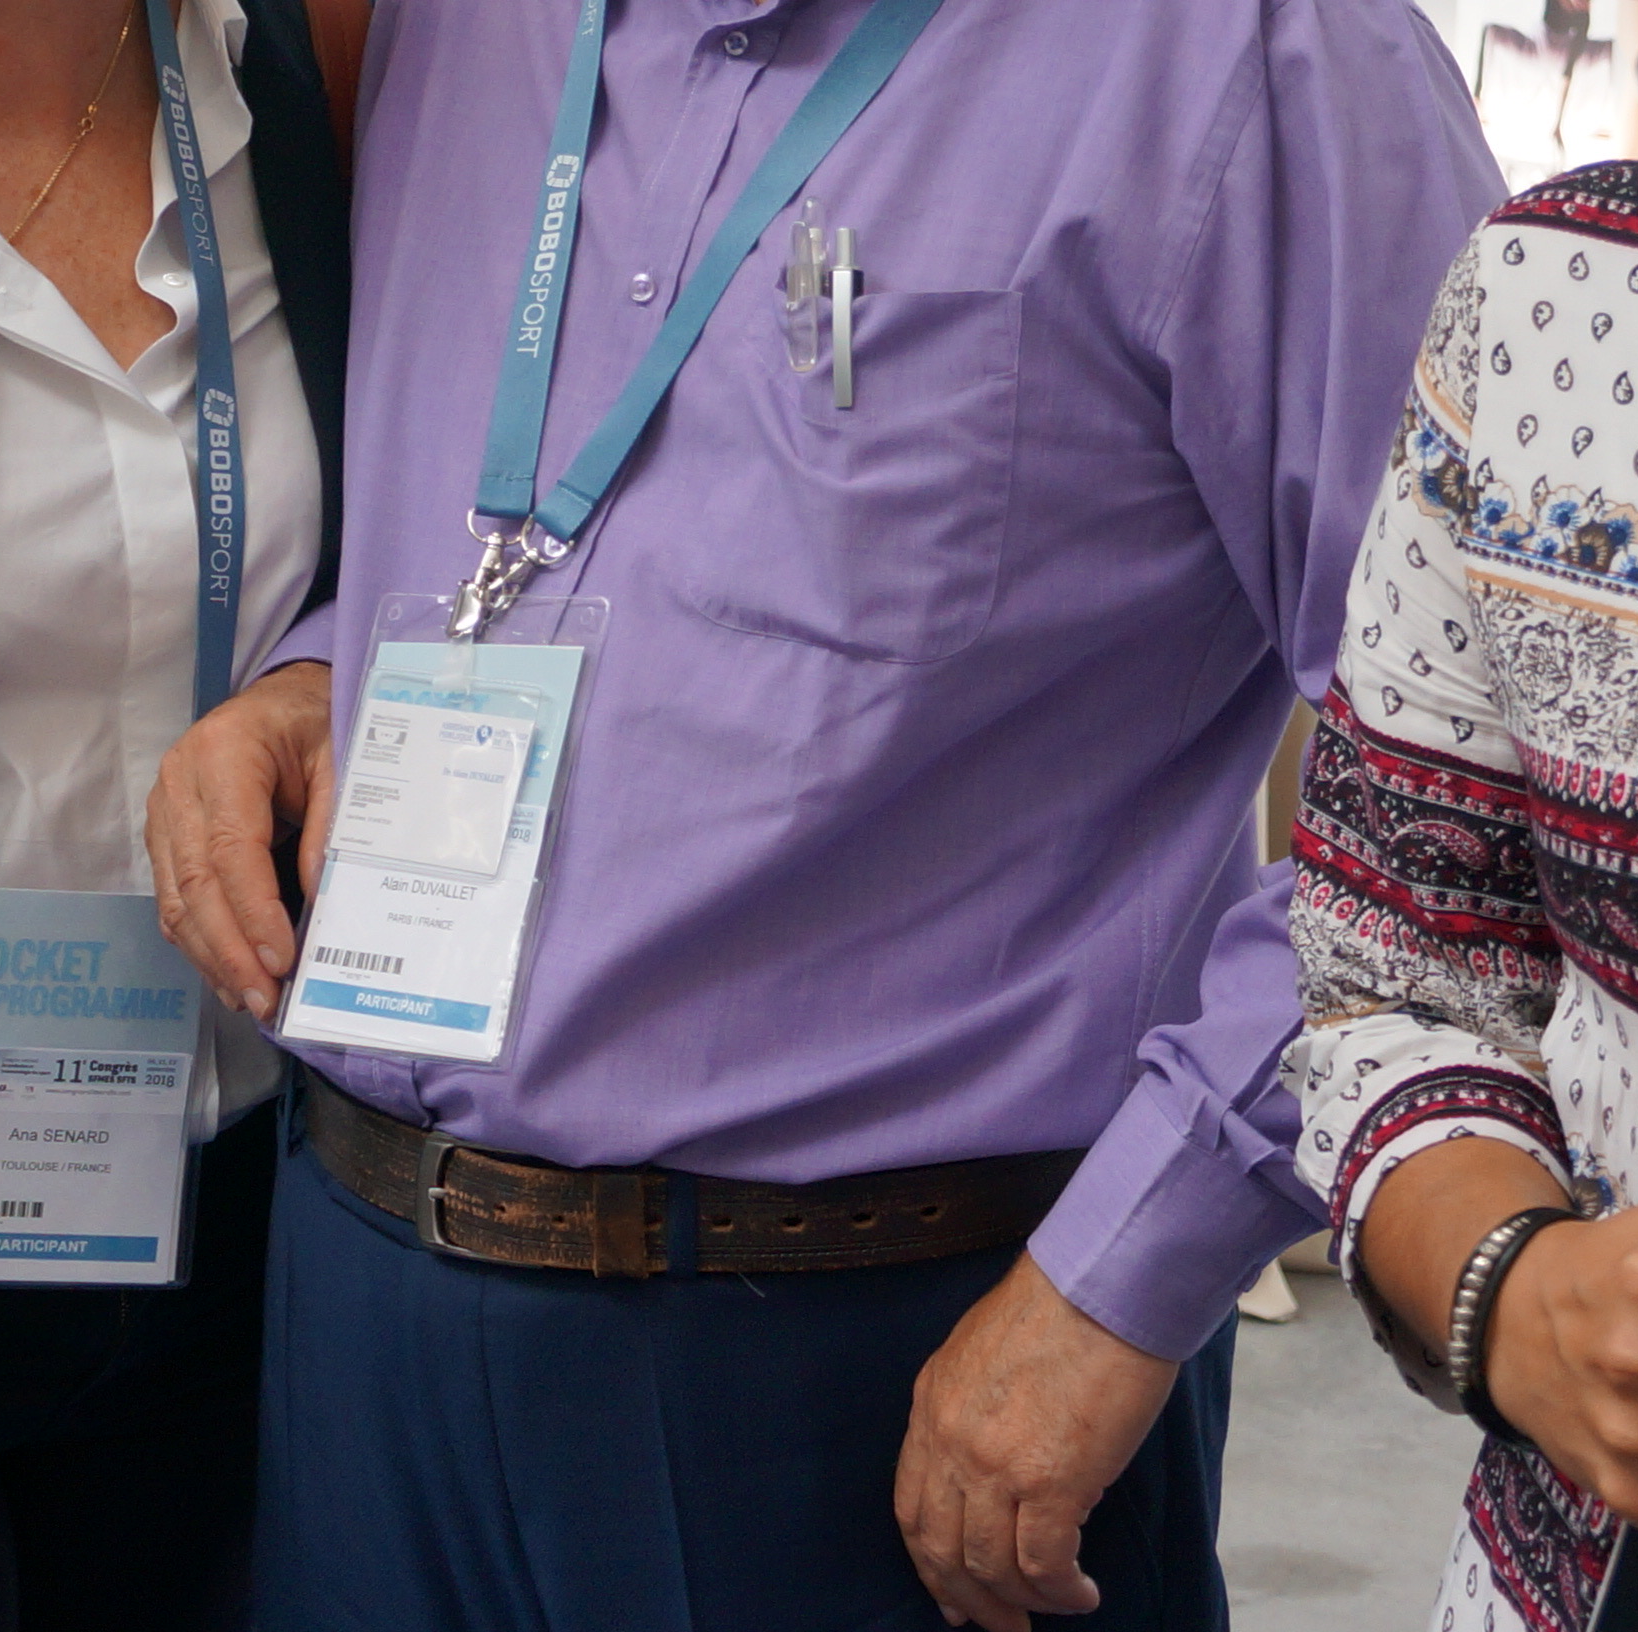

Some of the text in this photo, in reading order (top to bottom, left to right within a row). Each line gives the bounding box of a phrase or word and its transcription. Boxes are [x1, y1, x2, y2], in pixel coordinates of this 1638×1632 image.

[169, 101, 219, 266] BOBOSPORT
[516, 191, 569, 360] BOBOSPORT
[209, 428, 231, 609] BOBOSPORT
[509, 827, 531, 843] 018
[380, 875, 478, 902] Alain DUVALLET
[387, 912, 413, 928] PARIS
[420, 916, 454, 931] FRANCE
[356, 992, 433, 1017] PARTICIPANT
[90, 1060, 139, 1076] Congrès
[144, 1074, 175, 1088] 2018
[8, 1127, 110, 1145] Ana SENARD
[1, 1159, 59, 1174] TOULOUSE
[67, 1161, 112, 1175] FRANCE
